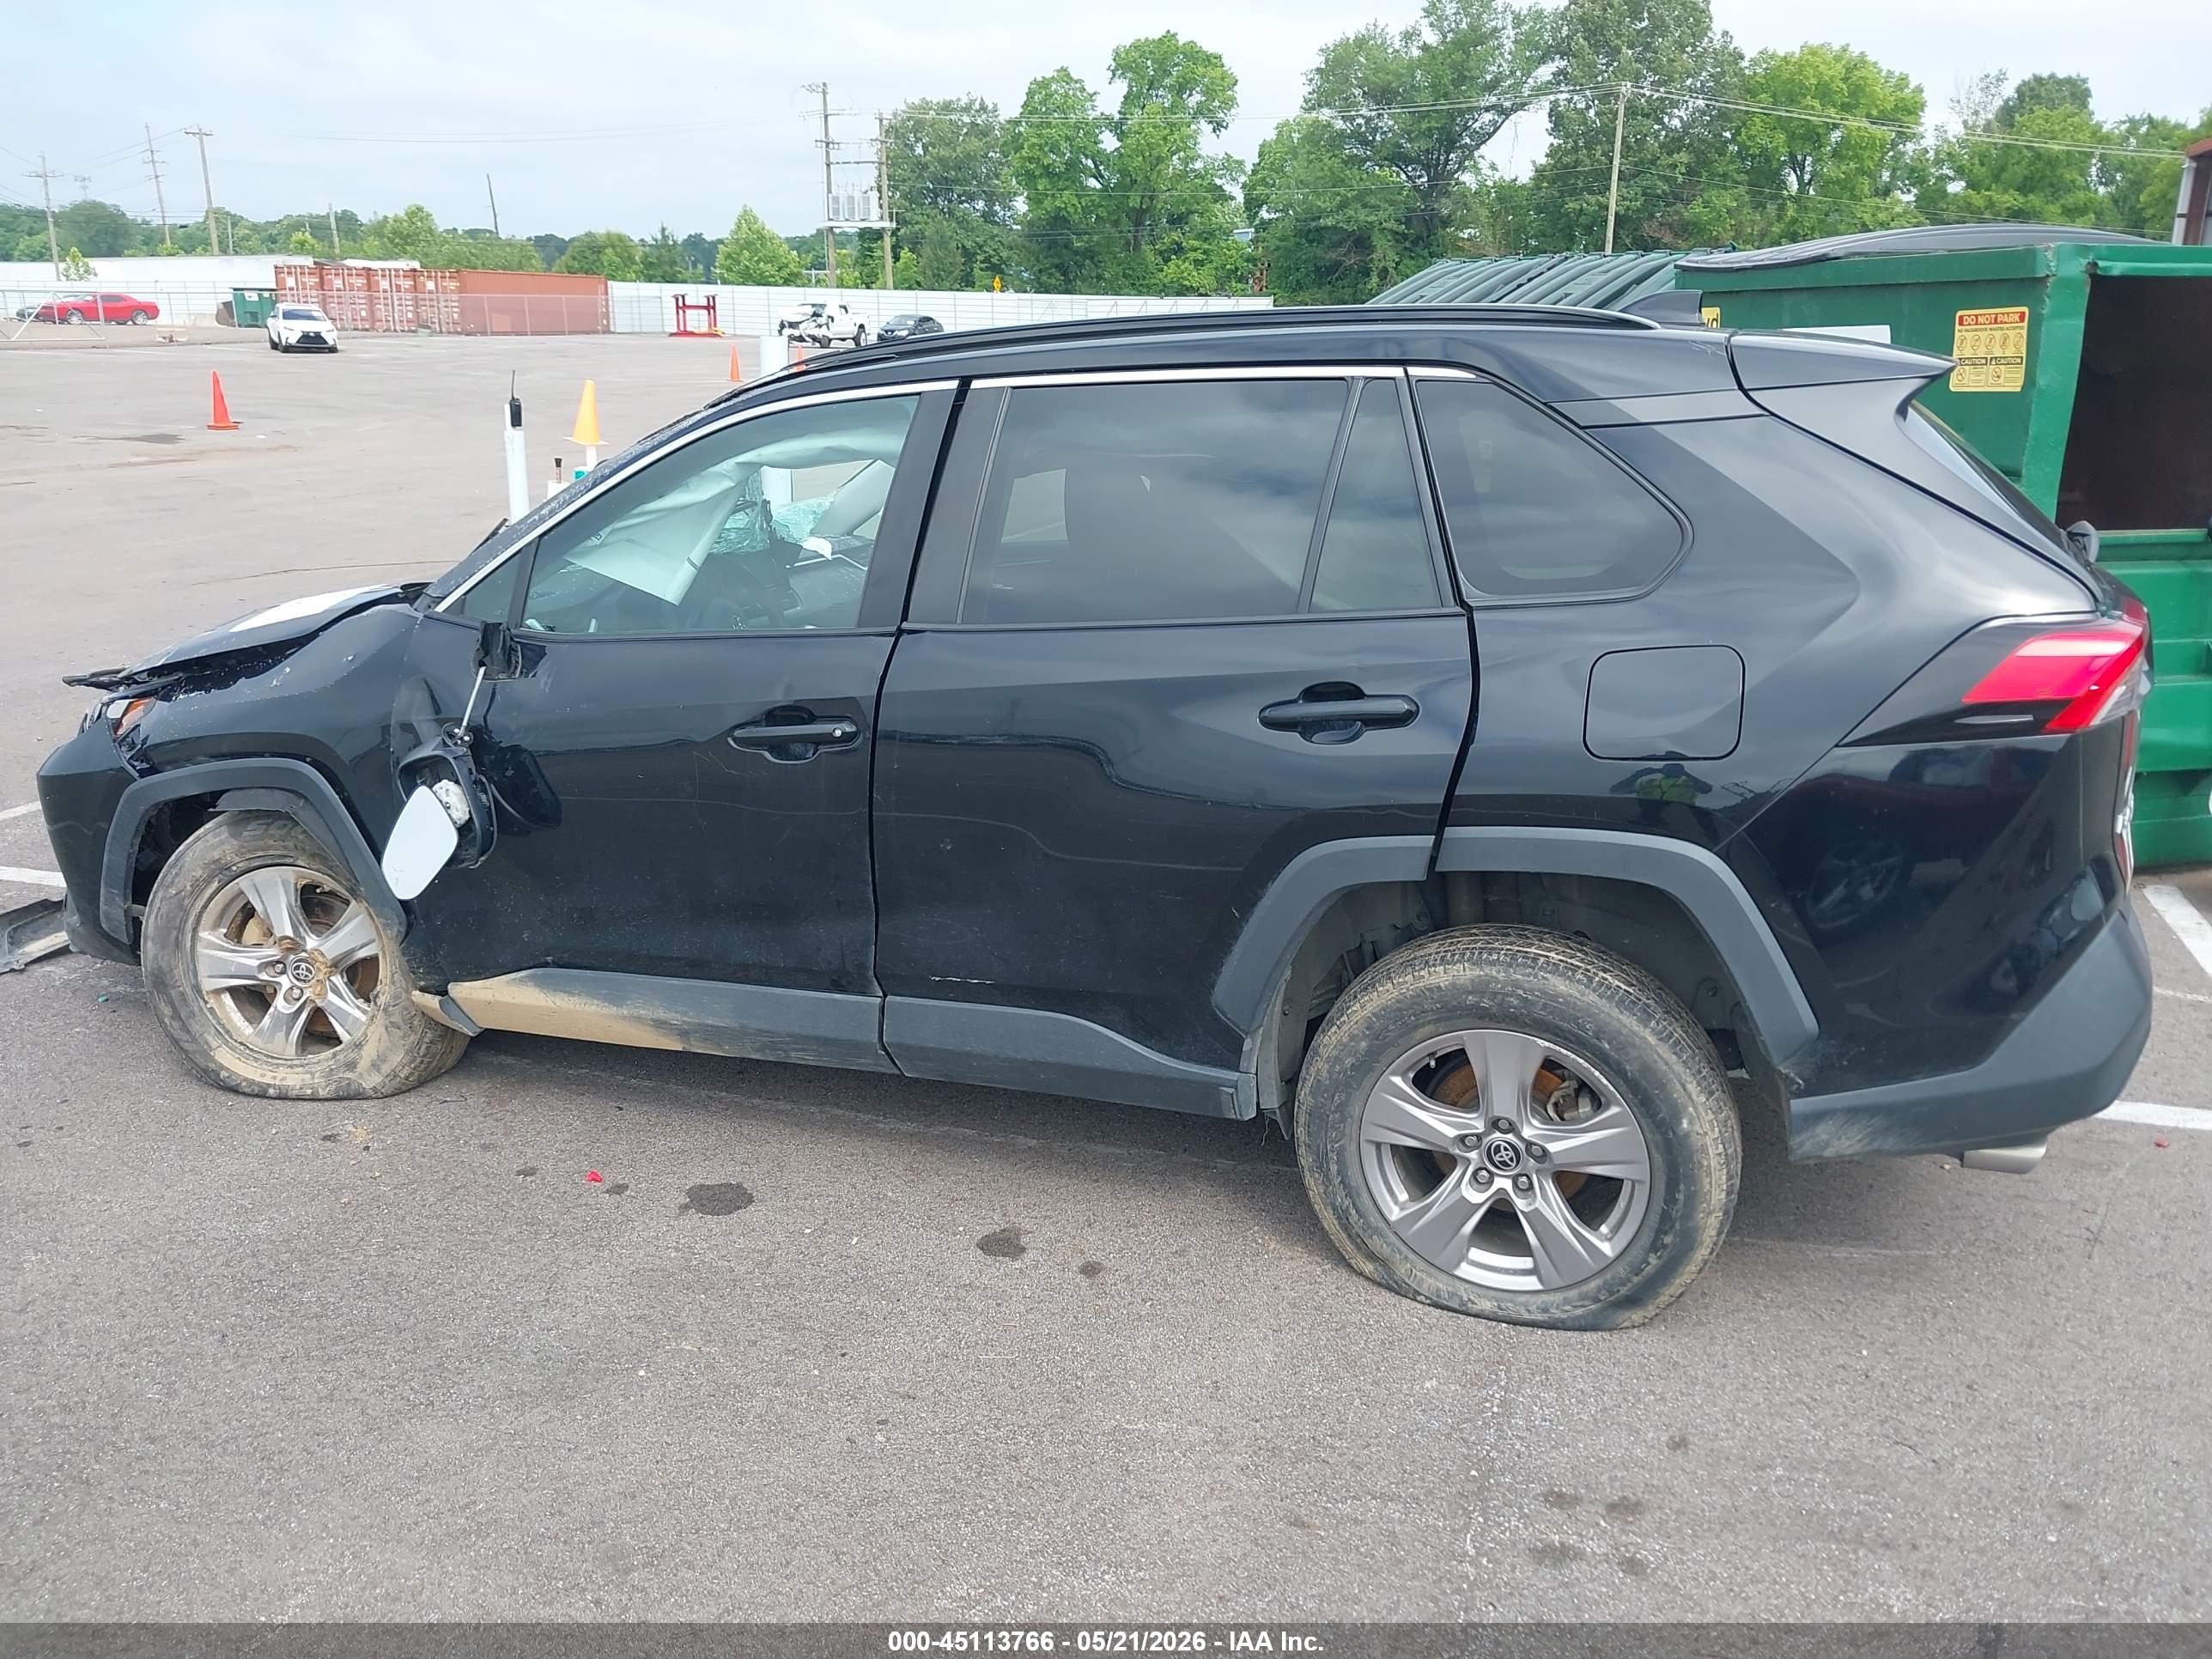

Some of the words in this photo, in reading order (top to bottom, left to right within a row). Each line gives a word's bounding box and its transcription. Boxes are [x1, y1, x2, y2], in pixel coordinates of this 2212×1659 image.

[1963, 315, 1976, 325] DO
[1978, 314, 1996, 324] NOT
[1997, 313, 2021, 323] PARK
